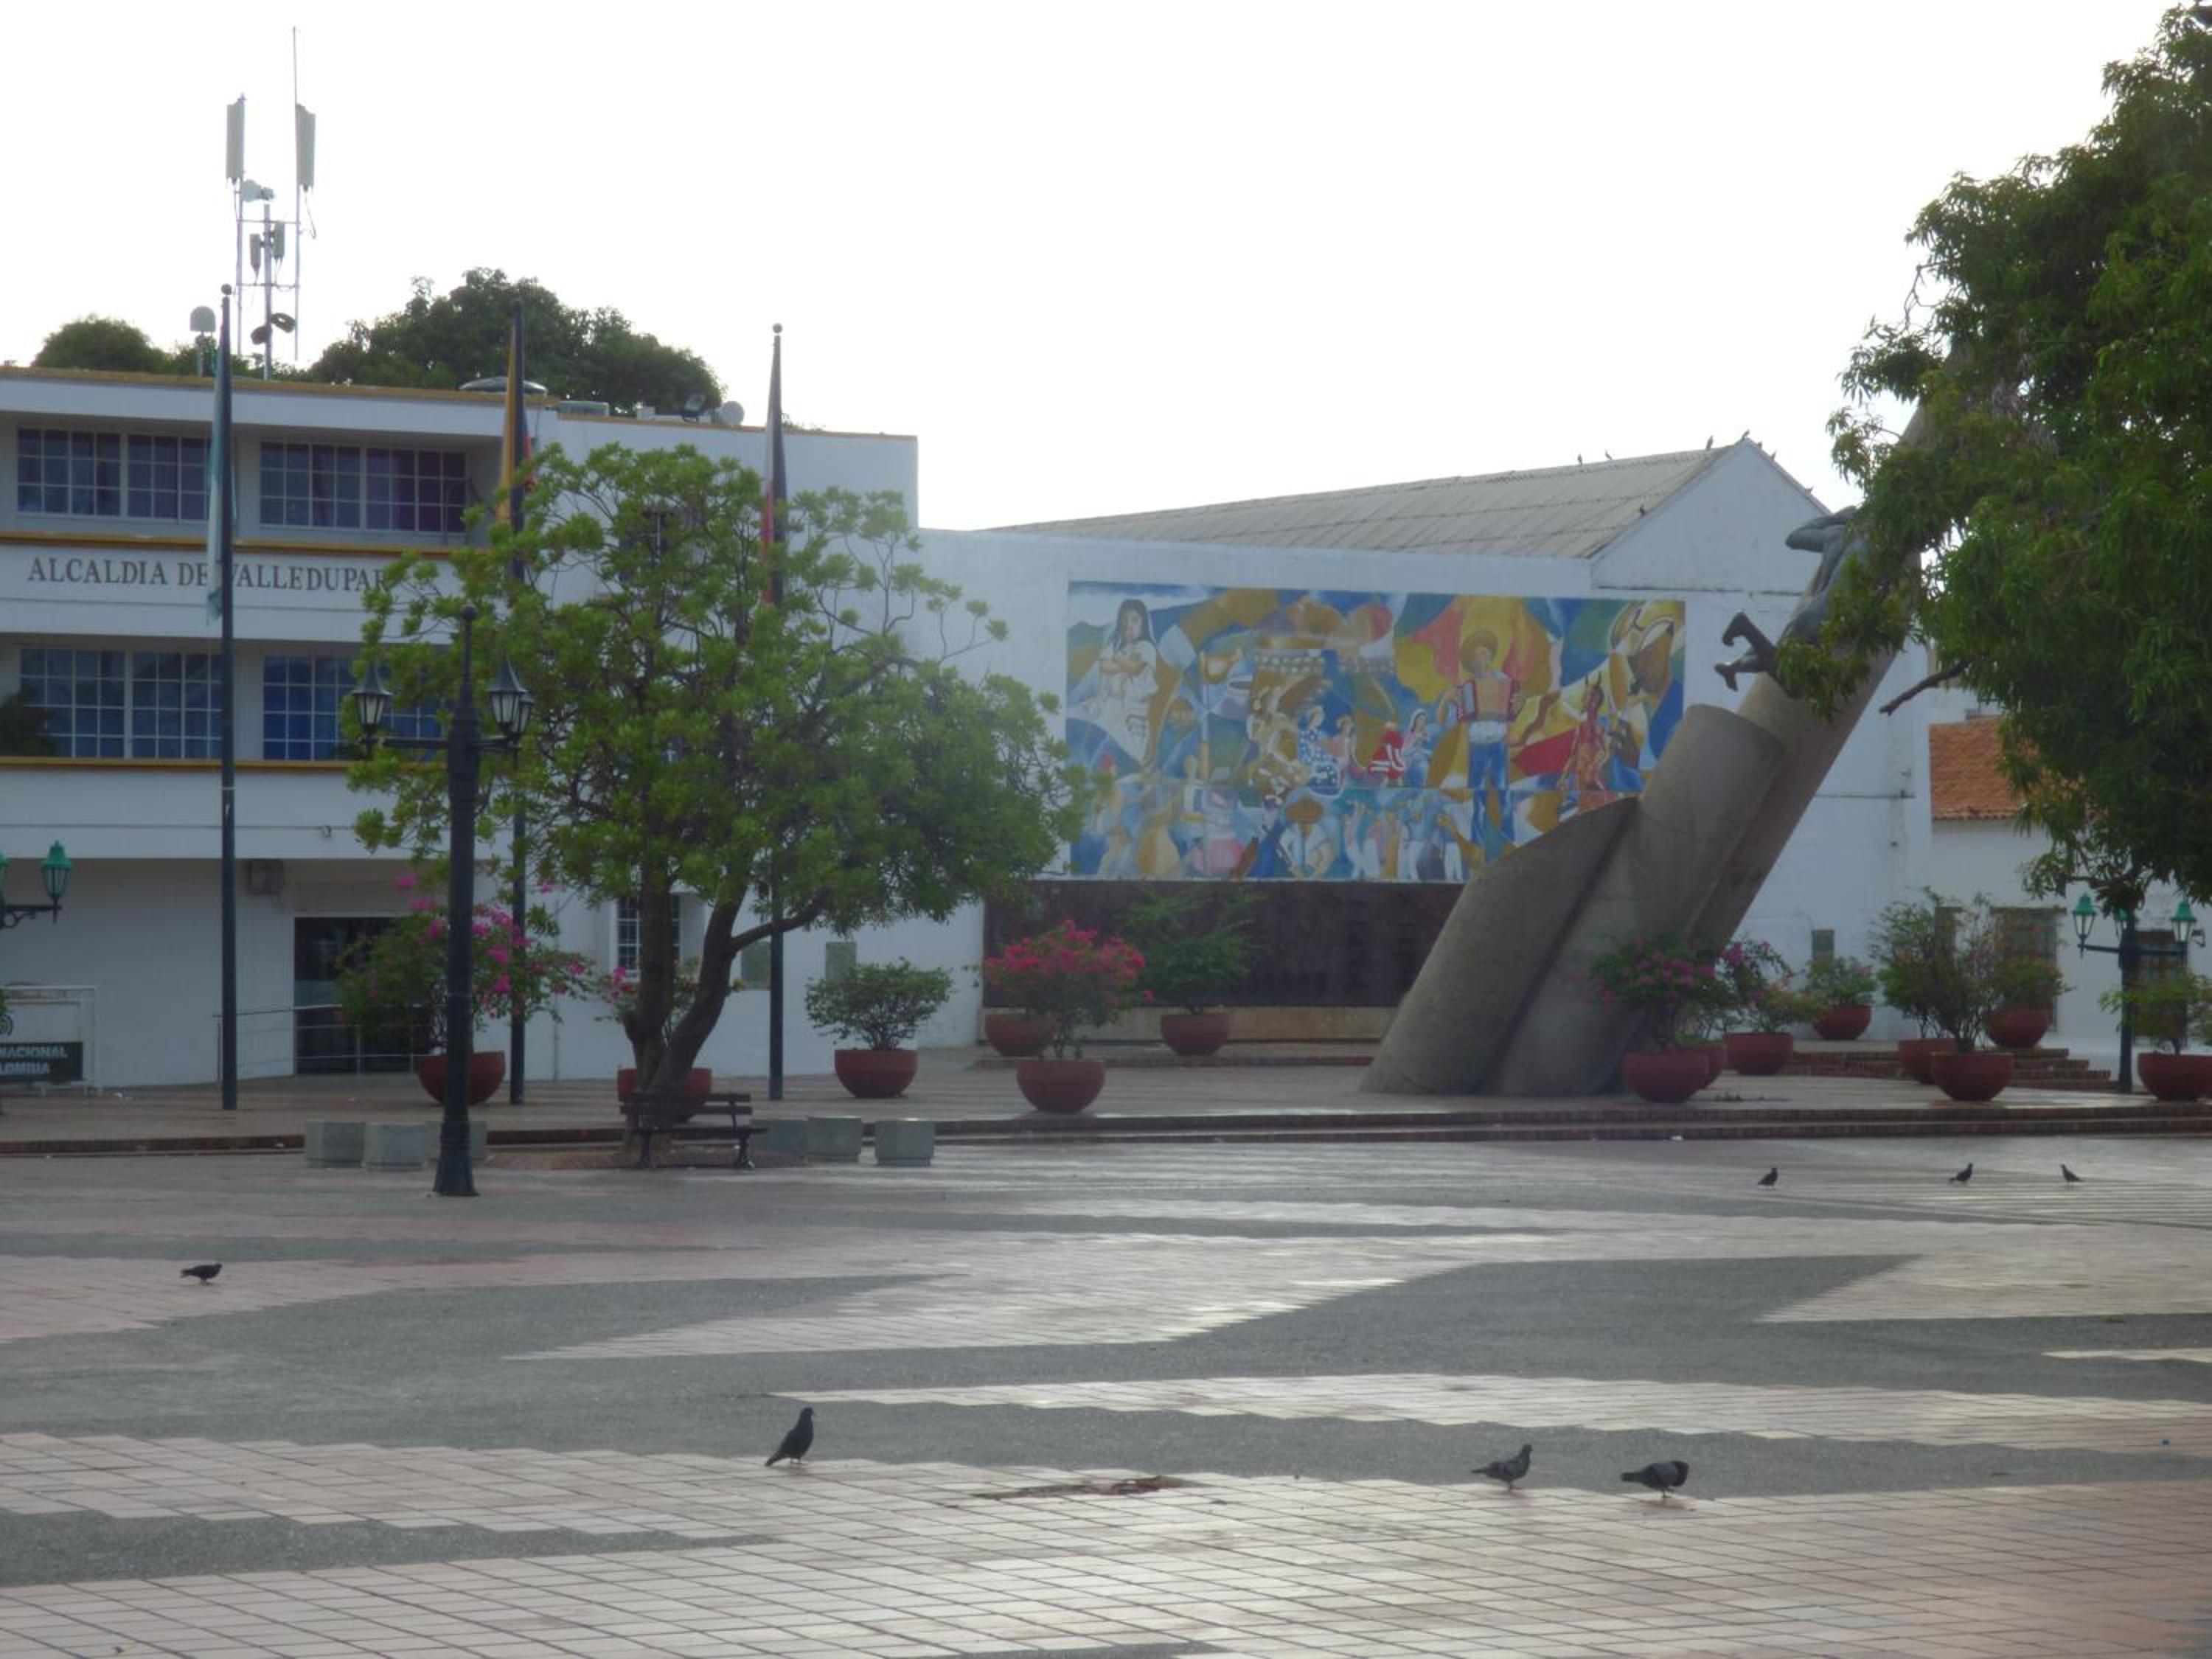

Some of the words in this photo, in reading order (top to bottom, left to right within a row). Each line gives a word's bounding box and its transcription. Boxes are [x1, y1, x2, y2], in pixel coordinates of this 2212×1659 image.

[28, 557, 168, 586] ALCALDIA
[177, 562, 209, 587] DE
[231, 563, 388, 592] ALLEDUPAR
